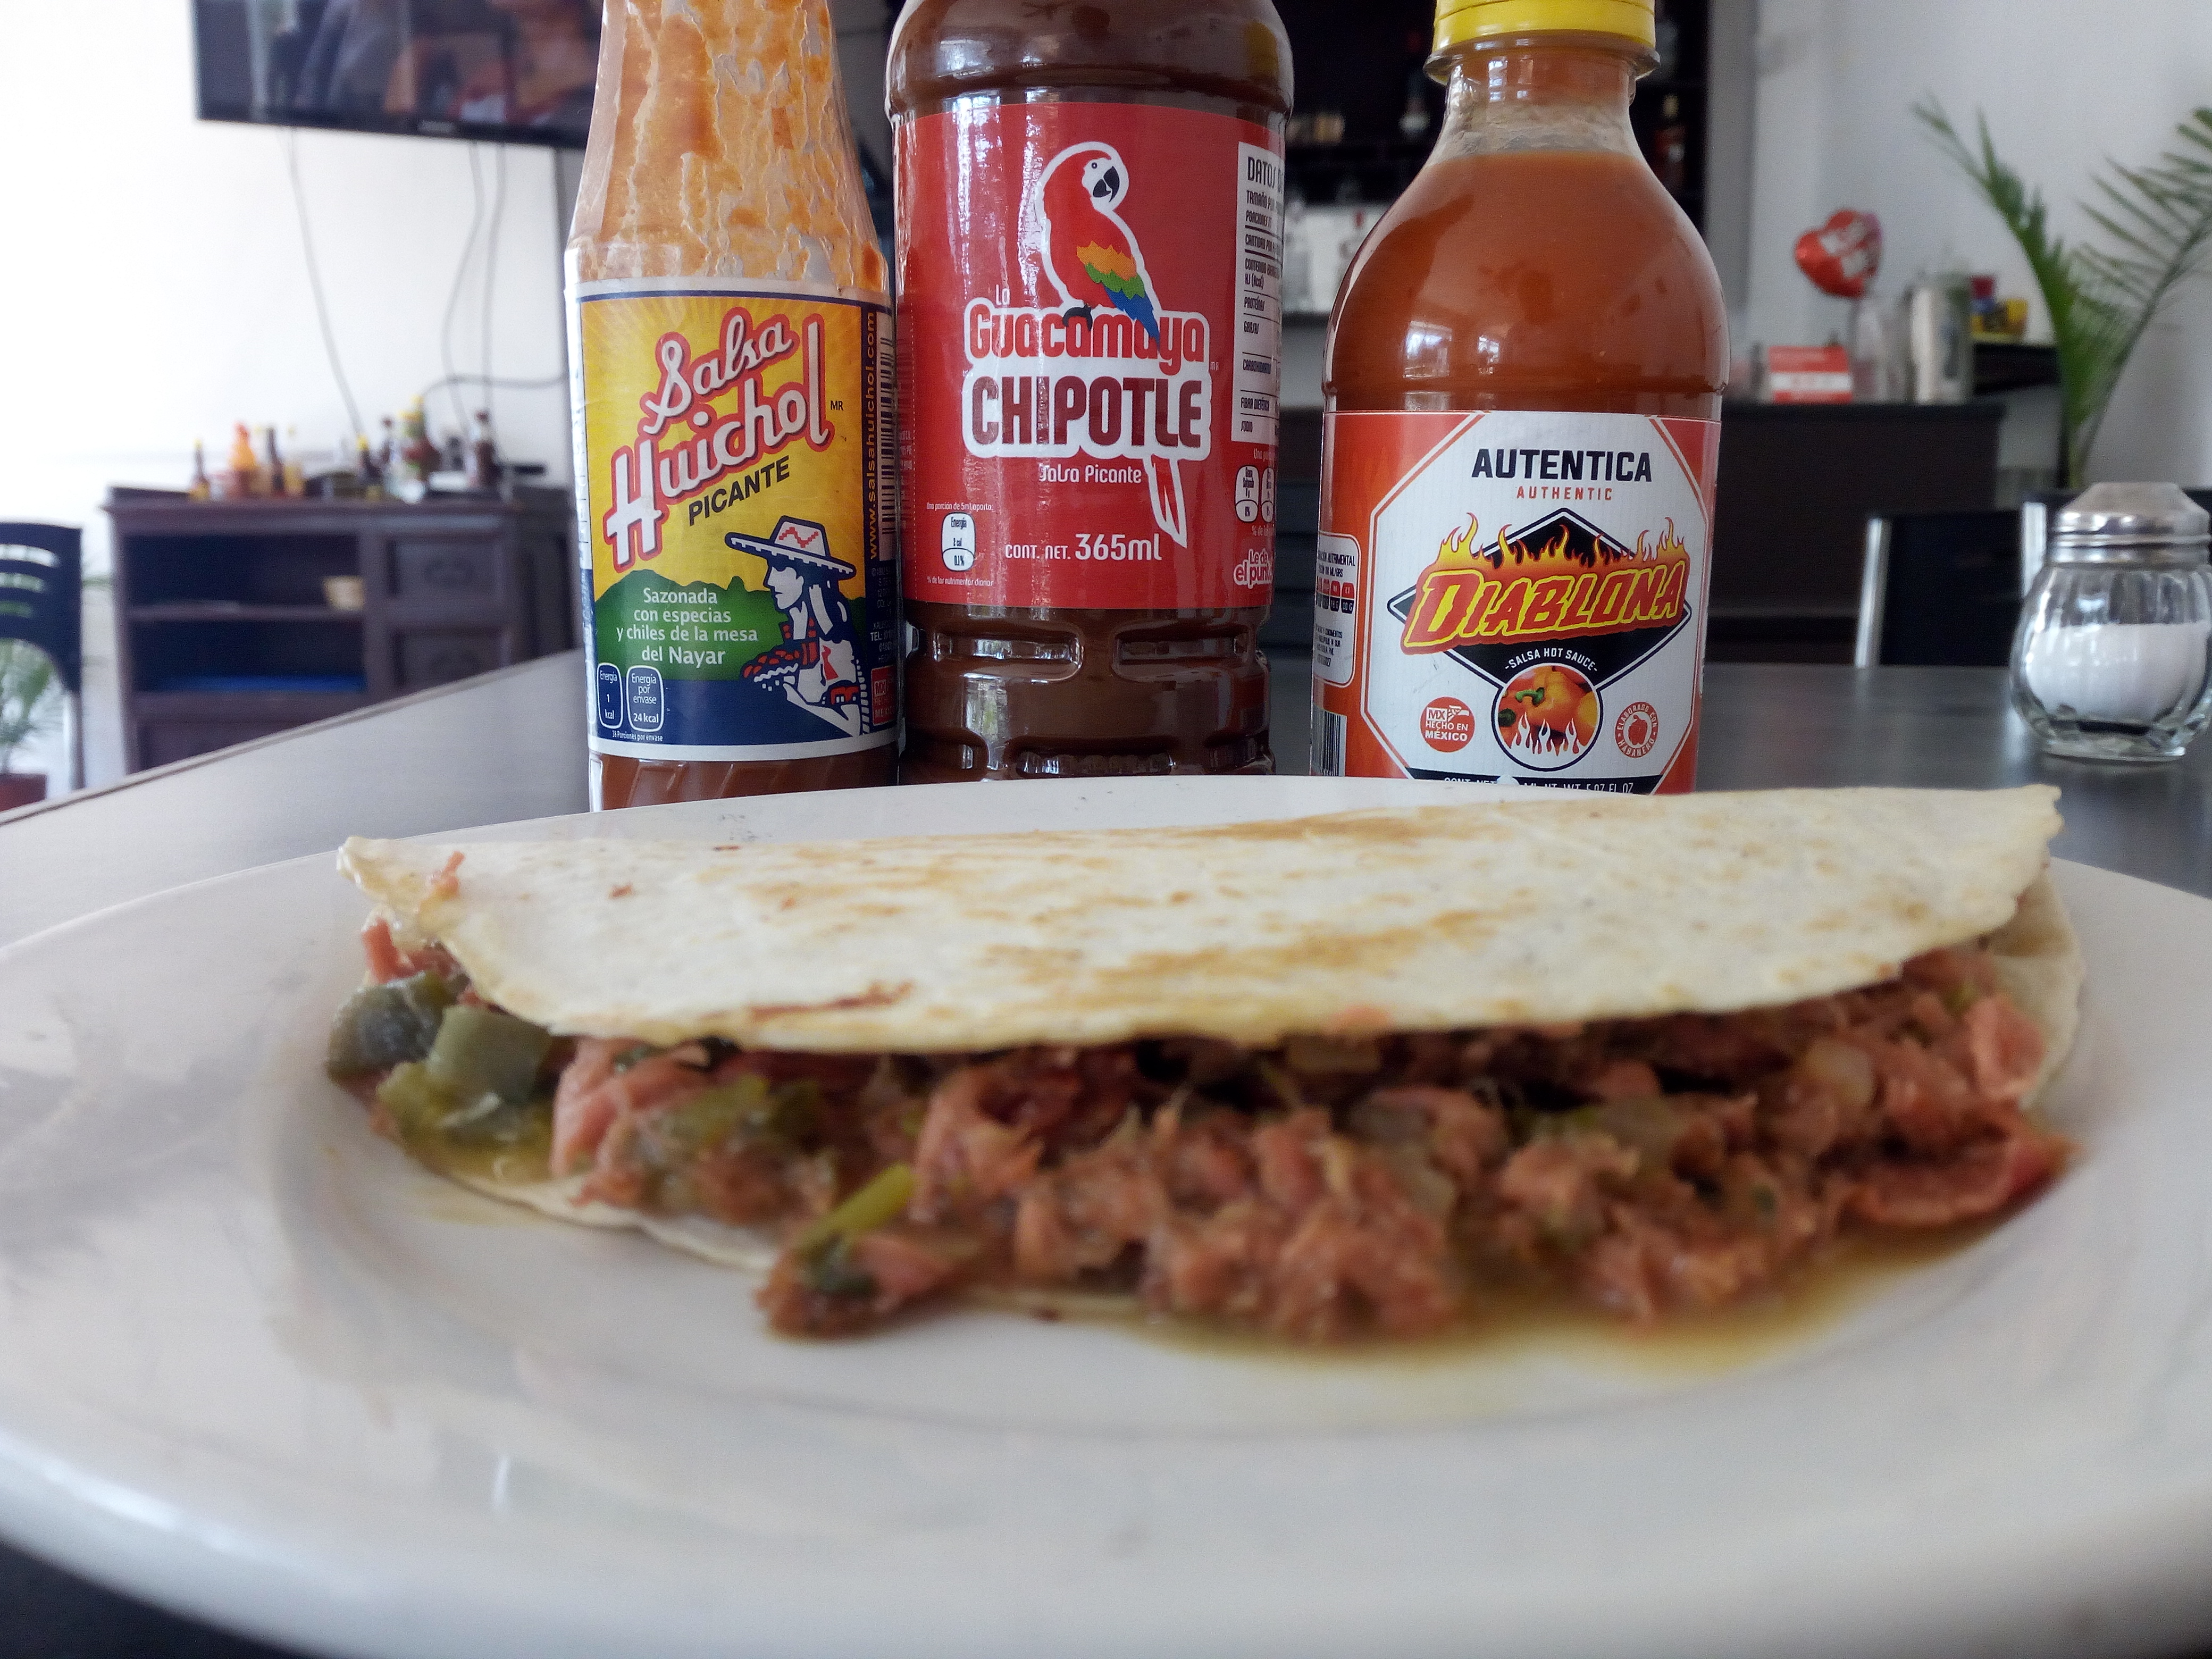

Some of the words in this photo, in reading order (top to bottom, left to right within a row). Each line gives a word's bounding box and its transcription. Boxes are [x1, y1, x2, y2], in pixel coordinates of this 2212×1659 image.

[970, 304, 1205, 376] Guacamaya
[642, 313, 794, 435] Salsa
[972, 375, 1202, 448] CHIPOTLE
[606, 321, 830, 566] Huichol
[830, 400, 843, 410] MR
[865, 312, 877, 559] www.salsahuichol.com
[1038, 464, 1079, 483] Salsa
[1085, 464, 1142, 483] Picante
[1471, 449, 1652, 482] AUTENTICA
[689, 455, 790, 526] PICANTE
[1516, 486, 1613, 500] AUTHENTIC
[935, 502, 952, 511] porción
[1075, 533, 1162, 560] 365ml
[643, 588, 717, 604] Sazonada
[1404, 560, 1685, 648] DIABLONA
[634, 609, 658, 622] con
[663, 608, 731, 625] especias
[616, 627, 623, 642] y
[626, 624, 665, 641] chiles
[670, 625, 689, 641] de
[694, 625, 708, 641] la
[714, 629, 758, 641] mesa
[642, 646, 663, 661] del
[669, 646, 726, 668] Nayar
[1544, 648, 1563, 657] HOT
[600, 670, 617, 684] Energía
[631, 673, 657, 686] Energía
[606, 693, 610, 703] 1
[638, 685, 650, 696] por
[605, 709, 615, 719] kcal
[633, 713, 642, 722] 24
[643, 713, 659, 723] kcal
[1429, 709, 1445, 720] MX
[1426, 720, 1454, 730] HECHO
[617, 731, 636, 740] Porciones
[1618, 738, 1655, 757] HABANERO
